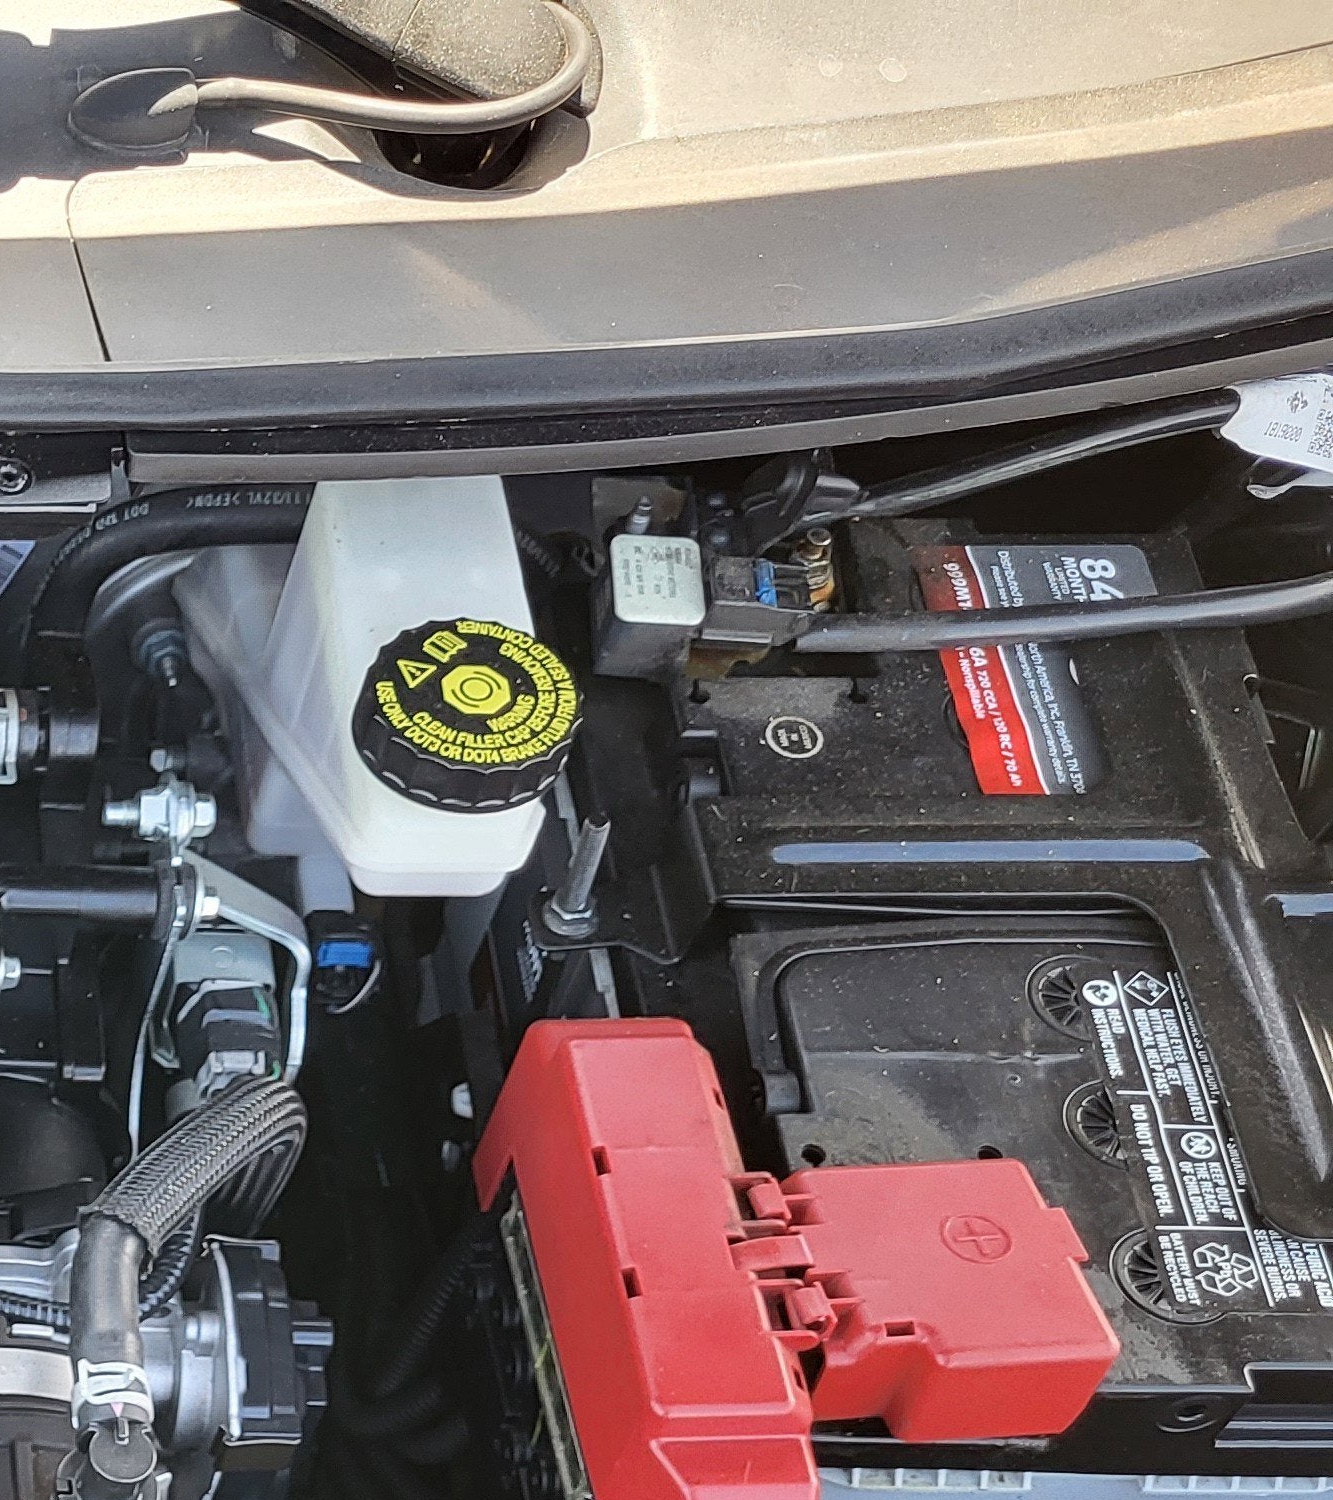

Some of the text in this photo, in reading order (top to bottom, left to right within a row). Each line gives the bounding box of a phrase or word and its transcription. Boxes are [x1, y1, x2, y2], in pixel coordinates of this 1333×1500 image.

[1054, 567, 1070, 595] LIMITED
[1079, 558, 1125, 602] 84
[455, 620, 533, 650] CONTAINER
[529, 643, 571, 681] SEALED
[375, 680, 398, 704] USE
[413, 642, 557, 749] CLEAN FILLER CAP BEFORE REMOVING
[556, 690, 577, 720] FROM
[383, 702, 414, 730] ONLY
[486, 694, 535, 732] WARNING
[403, 726, 443, 752] DOT3
[541, 717, 571, 747] FLUID
[439, 744, 463, 760] OR
[462, 749, 501, 764] DOT4
[499, 737, 548, 763] BRAKE
[1105, 1008, 1126, 1035] READ
[1161, 1008, 1181, 1038] FLUSH
[1091, 1008, 1124, 1080] INSTRUCTIONS.
[1133, 1008, 1171, 1098] MEDICAL HELP FAST.
[1147, 1008, 1165, 1032] WITH
[1165, 1067, 1183, 1086] GET
[1169, 1038, 1189, 1063] EYES
[1177, 1062, 1208, 1123] IMMEDIATELY
[1129, 1104, 1175, 1218] DO NOT TIP OR OPEN.
[1179, 1161, 1211, 1225] OF CHILDREN.
[1193, 1161, 1221, 1214] THE REACH
[1207, 1161, 1238, 1222] KEEP OUT OF
[1158, 1235, 1187, 1303] BE RECYCLED
[1169, 1232, 1201, 1306] BATTERY MUST
[1217, 1262, 1233, 1280] Pb
[1253, 1228, 1287, 1302] SEVERE BURNS.
[1289, 1250, 1312, 1282] CAUSE
[1301, 1242, 1327, 1280] LFURIC
[1285, 1282, 1302, 1298] OR
